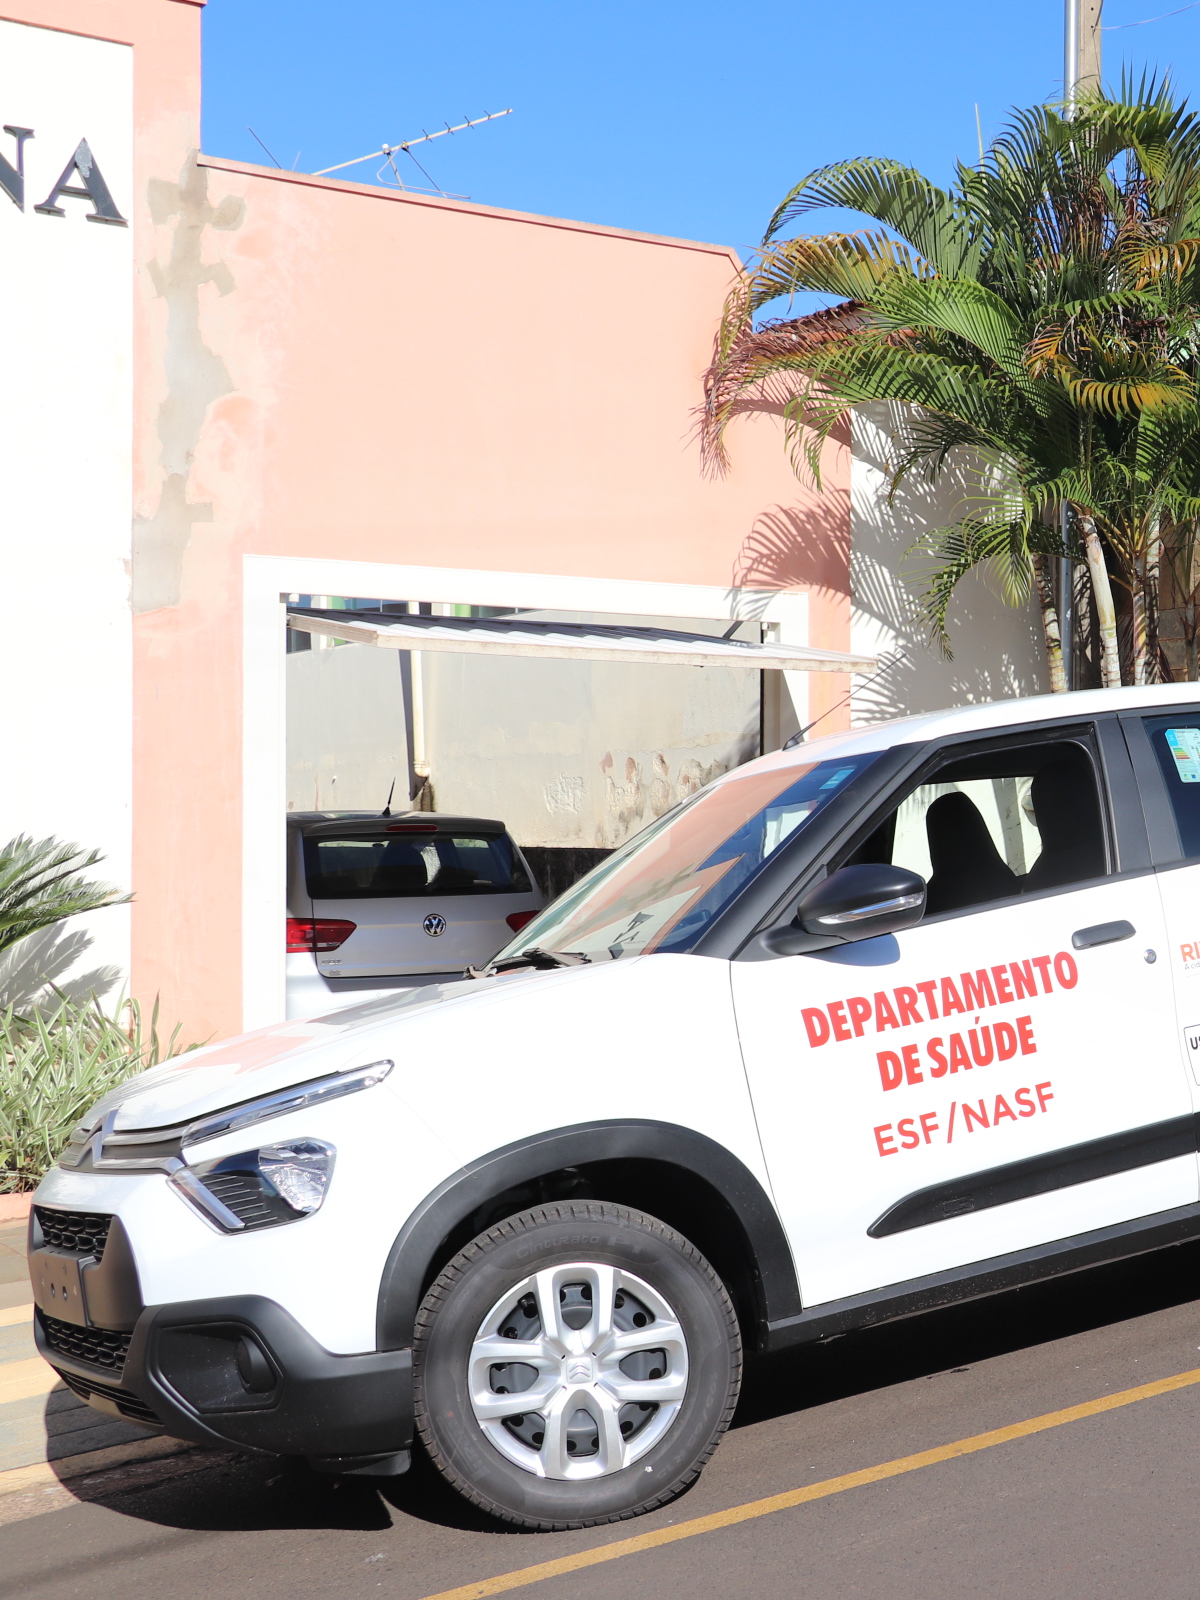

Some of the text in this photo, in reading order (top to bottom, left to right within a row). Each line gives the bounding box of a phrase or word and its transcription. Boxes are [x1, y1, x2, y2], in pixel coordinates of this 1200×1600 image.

[800, 951, 1079, 1048] DEPARTAMENTO
[876, 1015, 1037, 1092] DE SAÚDE
[873, 1081, 1055, 1157] ESF/NASF
[516, 1235, 600, 1260] Cinturato
